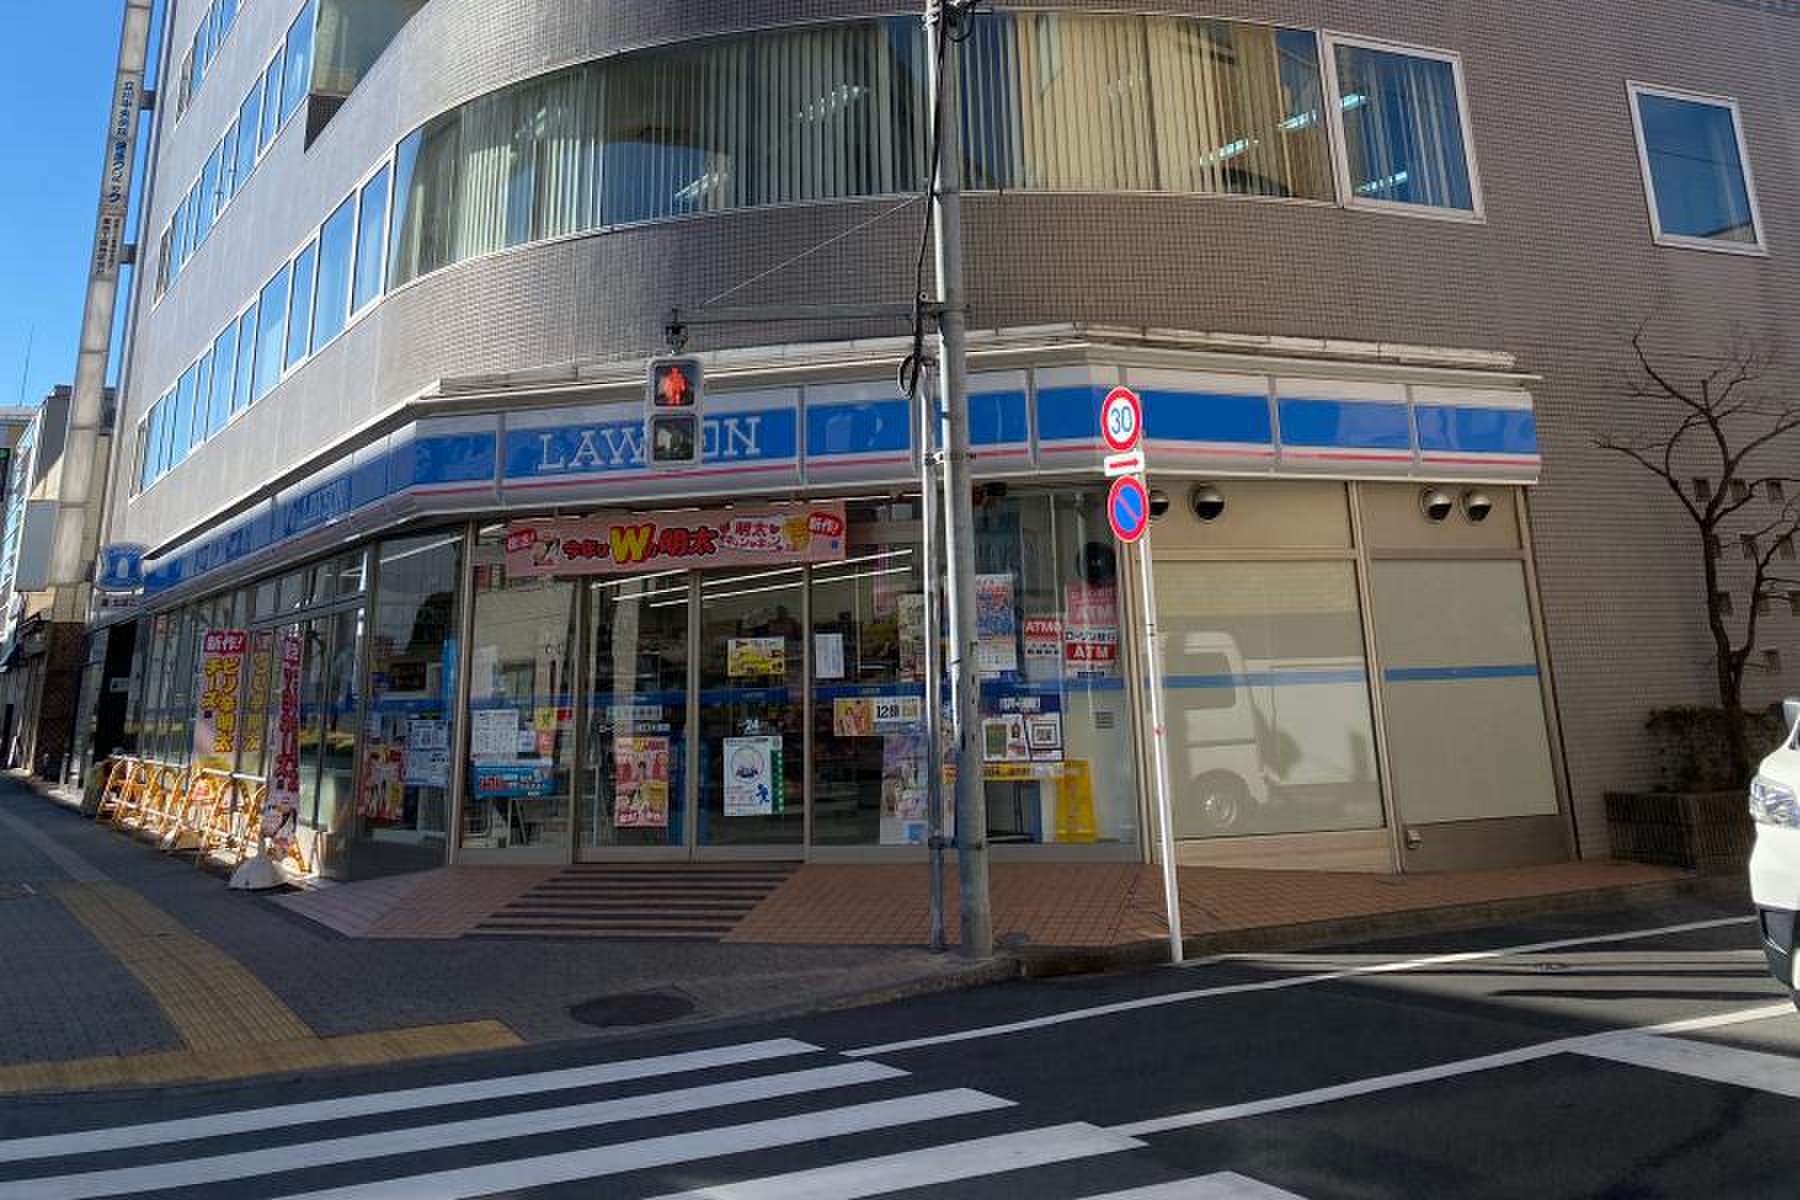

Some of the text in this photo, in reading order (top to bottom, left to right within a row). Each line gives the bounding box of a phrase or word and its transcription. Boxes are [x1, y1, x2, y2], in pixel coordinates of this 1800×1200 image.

[1110, 406, 1133, 434] 30
[537, 416, 761, 470] LAWON
[1073, 645, 1109, 659] ATM
